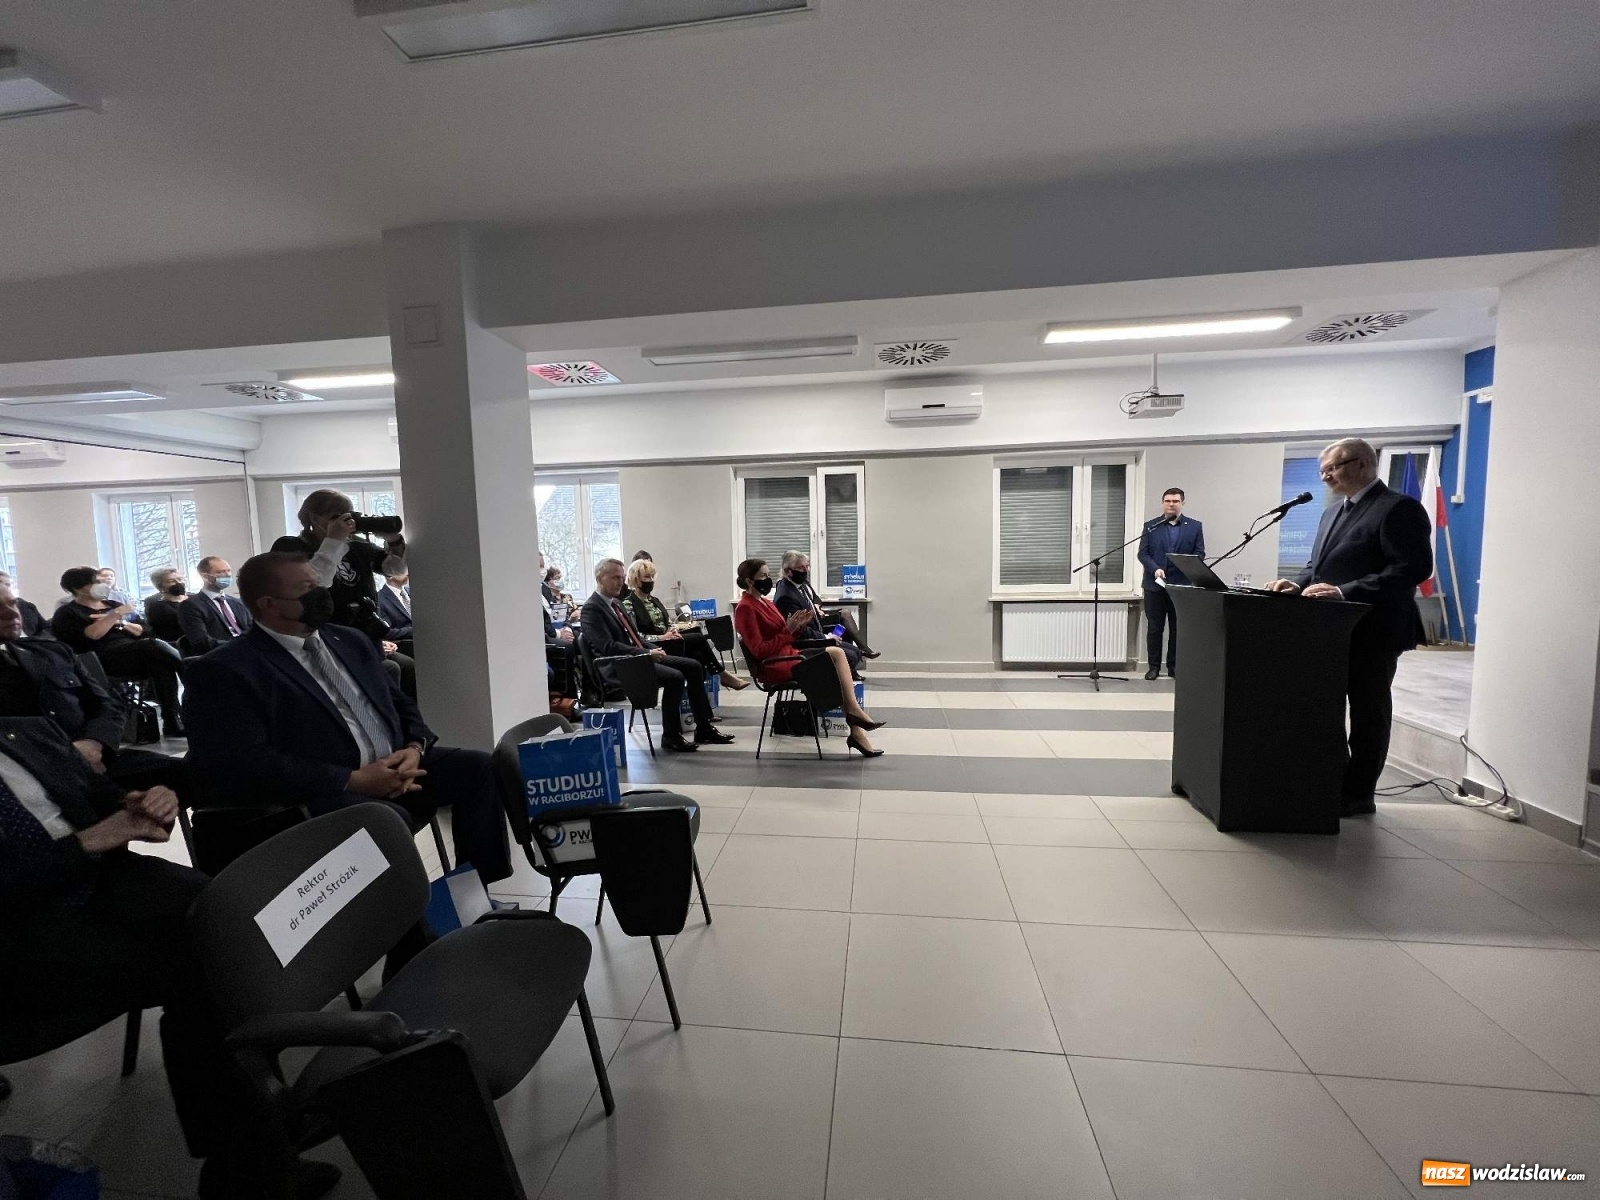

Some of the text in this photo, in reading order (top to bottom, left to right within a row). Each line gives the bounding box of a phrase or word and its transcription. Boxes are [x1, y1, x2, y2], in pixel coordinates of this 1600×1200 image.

[526, 770, 603, 795] STUDIUJ
[528, 787, 605, 806] W RACIBORZU!
[569, 829, 591, 841] PW
[297, 868, 329, 898] Rektor
[289, 917, 300, 931] dr
[298, 891, 328, 920] Paweł
